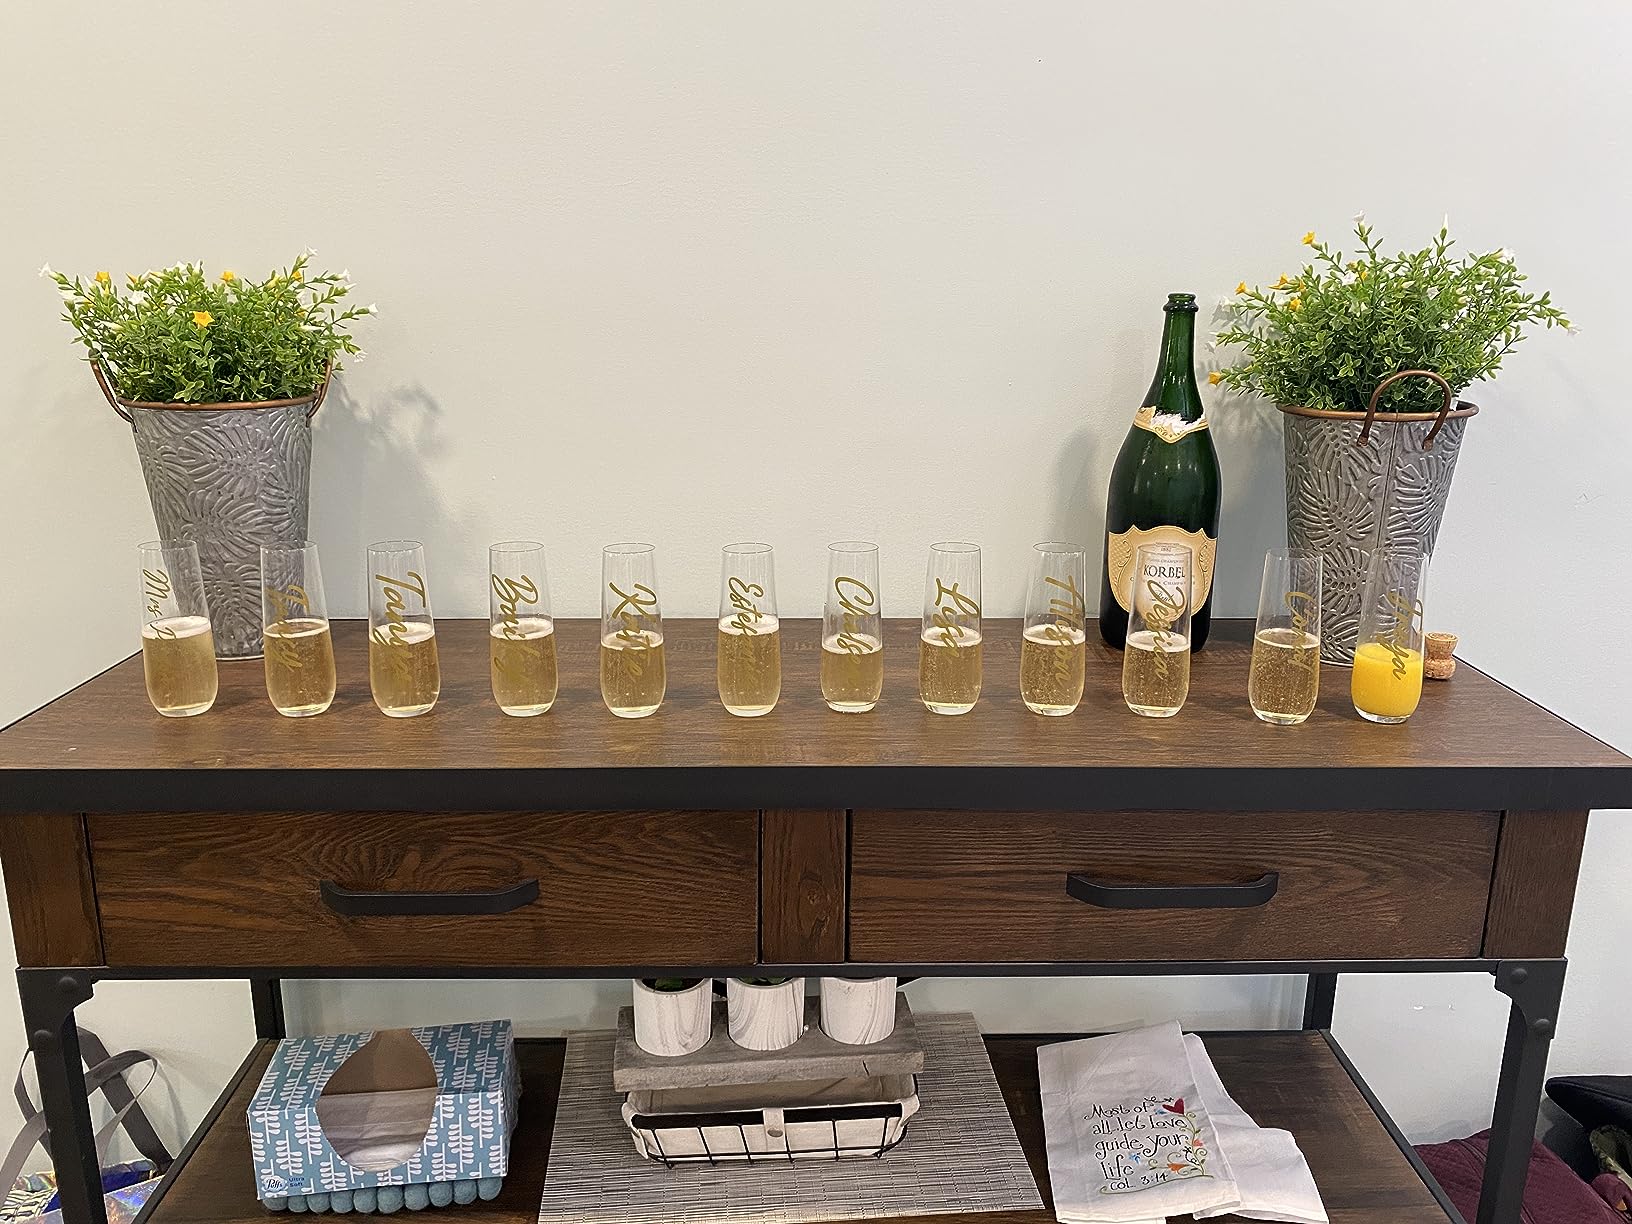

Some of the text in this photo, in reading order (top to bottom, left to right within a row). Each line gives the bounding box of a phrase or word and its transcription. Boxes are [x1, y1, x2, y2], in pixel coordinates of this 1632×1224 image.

[1143, 565, 1186, 578] KORBEL
[143, 569, 170, 618] Mrs
[933, 578, 980, 665] Lisa
[1146, 580, 1185, 680] Jessica
[1084, 1102, 1154, 1120] Most of
[1150, 1115, 1187, 1129] love
[1095, 1133, 1188, 1160] guide your
[266, 1179, 282, 1189] Puffs
[1141, 1173, 1168, 1184] 3:14
